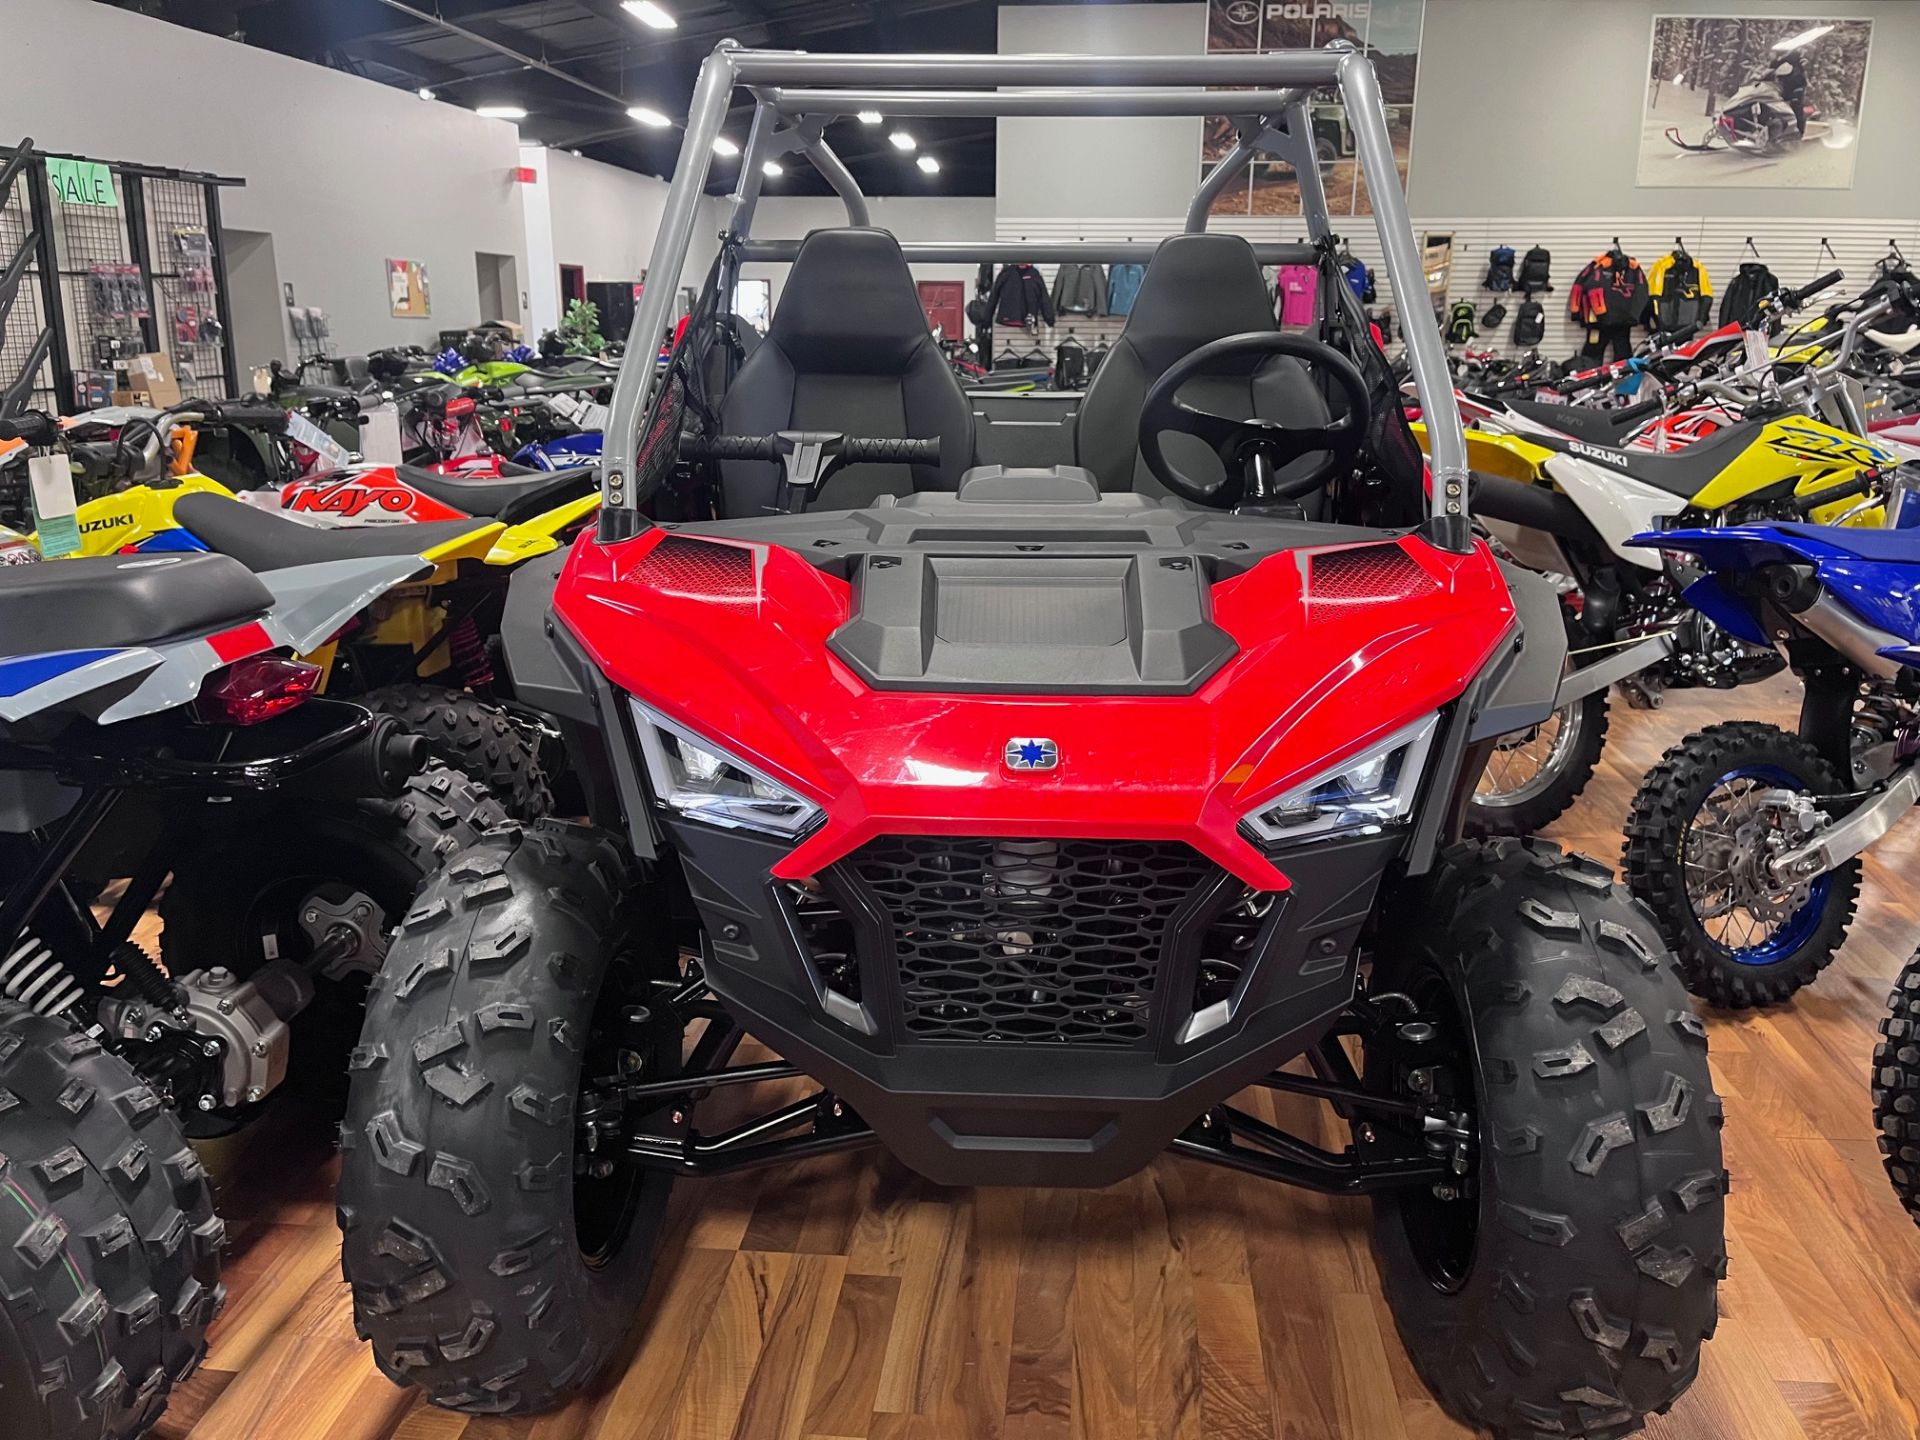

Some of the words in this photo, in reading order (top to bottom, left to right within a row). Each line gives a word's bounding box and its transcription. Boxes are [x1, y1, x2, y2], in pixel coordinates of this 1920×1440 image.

[1266, 3, 1370, 20] POLARIS
[52, 174, 107, 204] SALE
[1568, 441, 1628, 468] SUZUKI
[293, 487, 413, 517] KAYO
[79, 514, 135, 534] UZUKI
